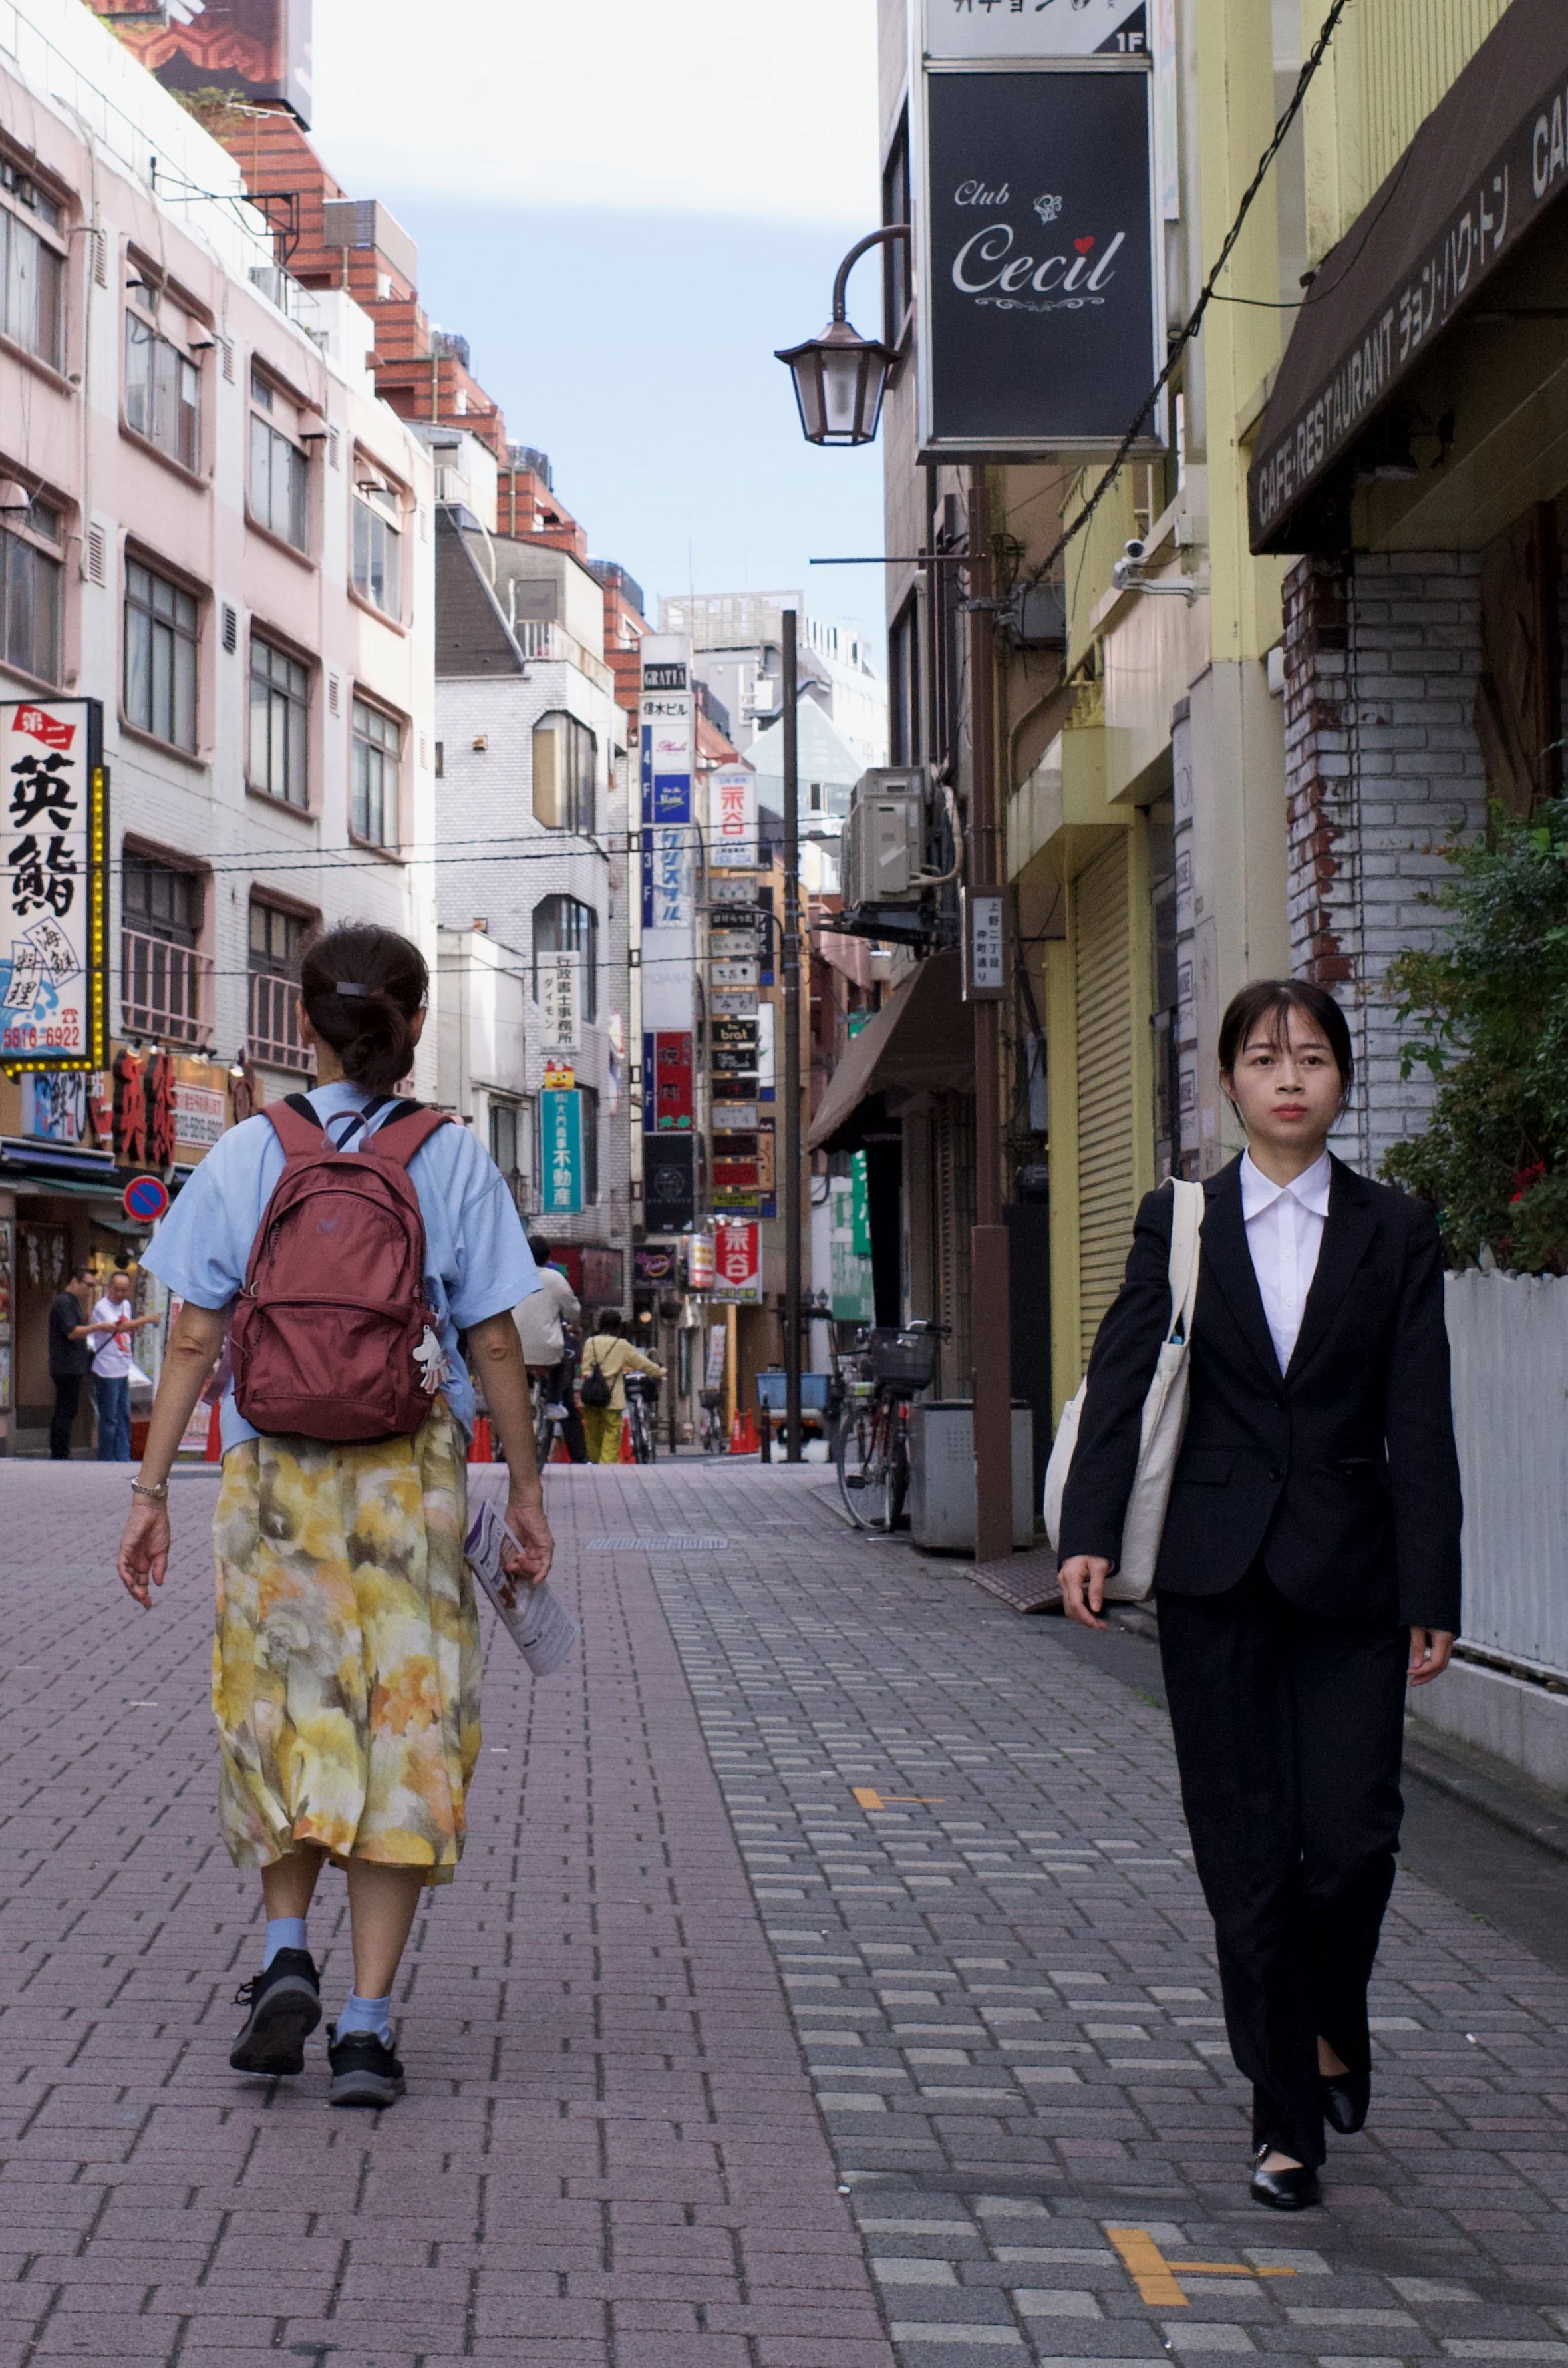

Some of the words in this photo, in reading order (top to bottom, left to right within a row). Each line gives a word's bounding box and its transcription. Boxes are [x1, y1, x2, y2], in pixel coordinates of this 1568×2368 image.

[1116, 33, 1144, 53] 1F
[1533, 83, 1568, 200] CA
[954, 179, 1009, 206] Club
[952, 223, 1125, 293] Cecil
[645, 670, 685, 685] GRATIA
[22, 711, 67, 745] 第二
[8, 753, 78, 917] 英鮨
[9, 950, 38, 1006] 料理
[36, 926, 76, 985] 海鮮
[544, 977, 555, 1029] ダイモン
[557, 955, 573, 1044] 行政書士事務所
[3, 1026, 80, 1048] 5816-6922
